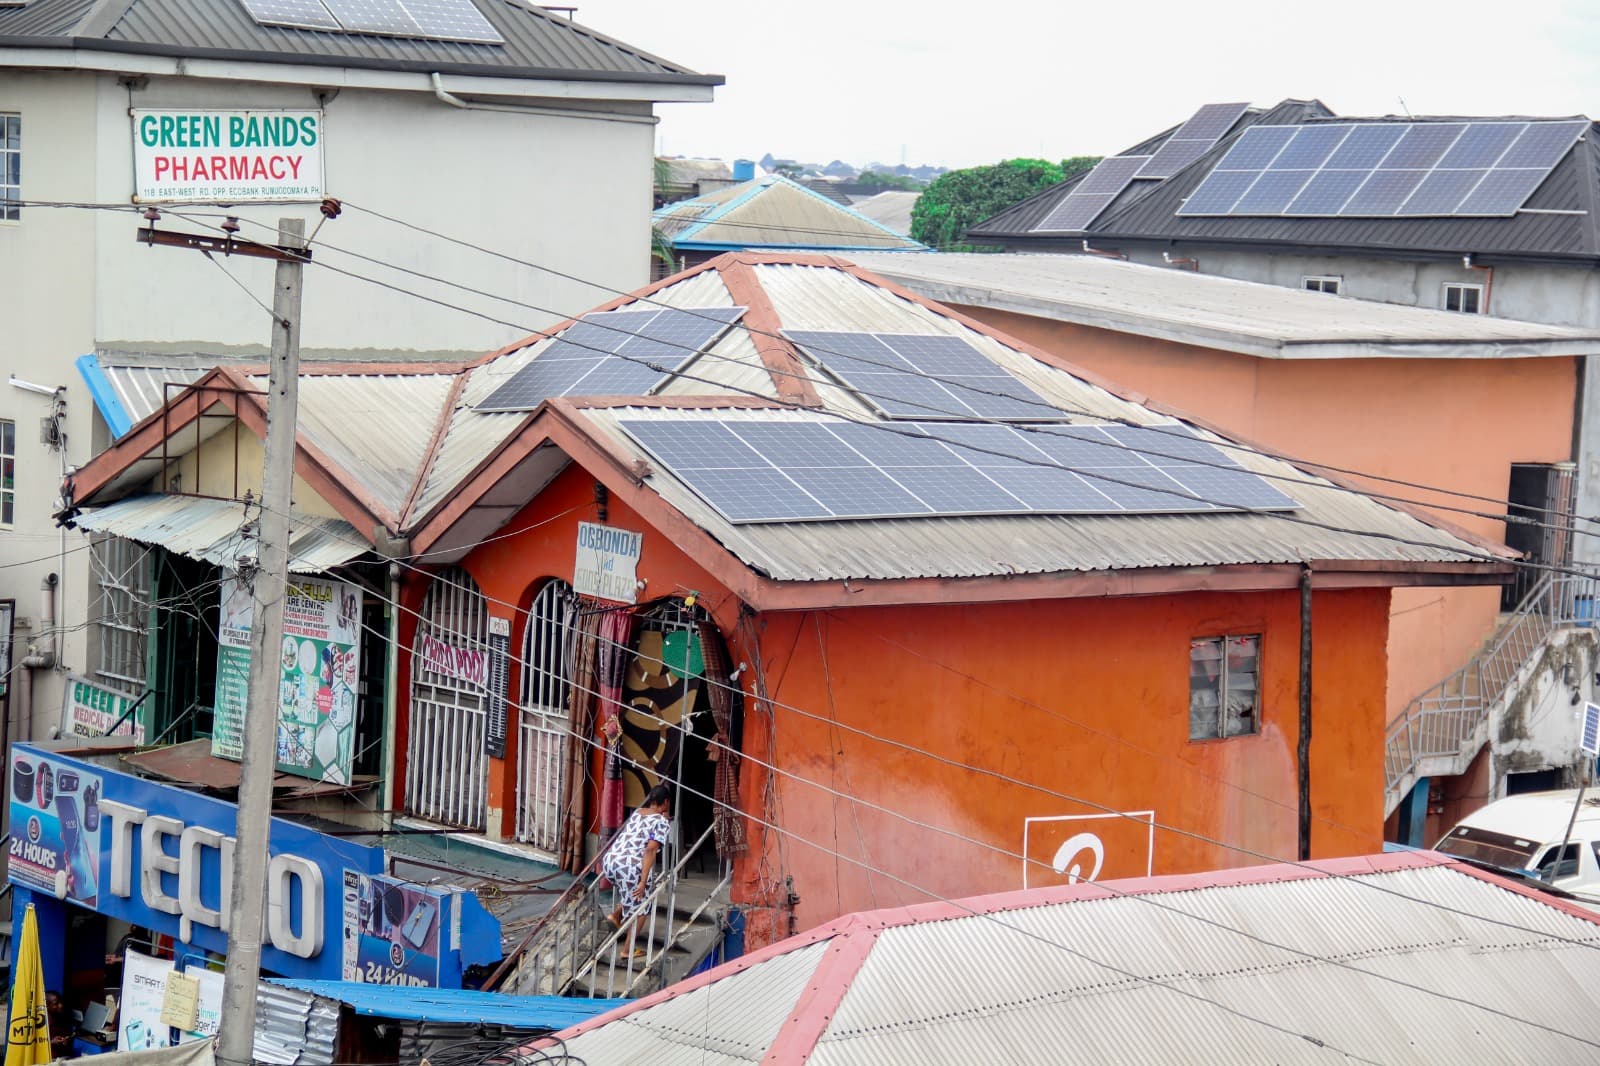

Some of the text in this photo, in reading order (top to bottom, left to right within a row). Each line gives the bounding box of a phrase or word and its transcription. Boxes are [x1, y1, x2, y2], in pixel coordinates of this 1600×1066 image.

[140, 115, 317, 148] GREEN BANDS
[154, 155, 303, 181] PHARMACY
[158, 187, 196, 197] EAST-WEST
[229, 186, 258, 196] ECOBANK
[579, 525, 638, 558] OGBONDA
[74, 682, 115, 716] GREEN
[74, 705, 105, 731] MEDICAL
[10, 837, 57, 869] 24 HOURS
[97, 799, 324, 959] TECO
[134, 974, 160, 988] SMART
[365, 961, 382, 984] 24
[13, 1025, 34, 1038] MT
